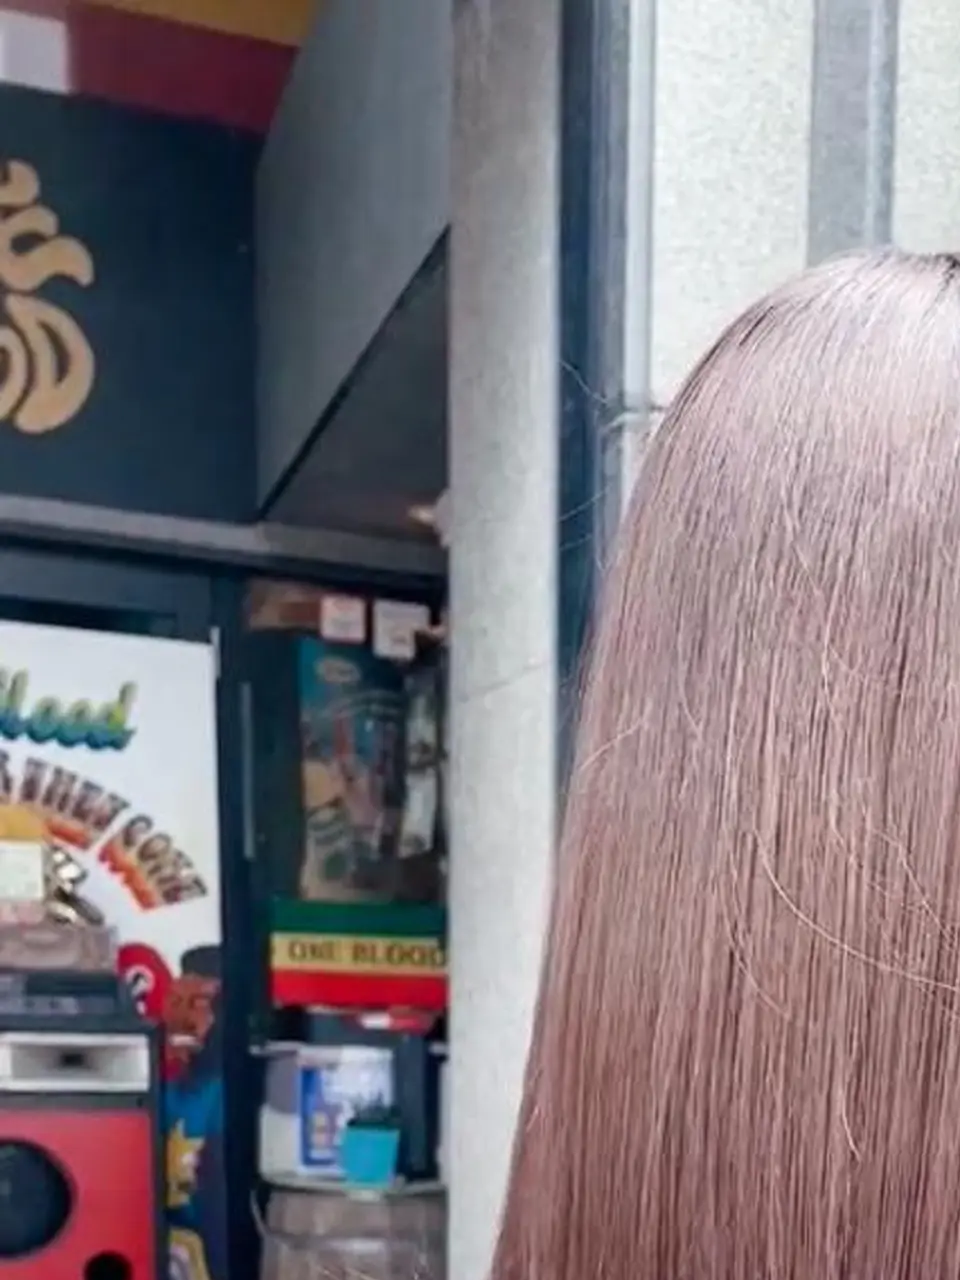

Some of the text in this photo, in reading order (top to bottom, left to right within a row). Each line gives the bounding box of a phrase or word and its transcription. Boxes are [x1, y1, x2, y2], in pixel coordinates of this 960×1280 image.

[0, 667, 137, 752] lood
[287, 939, 447, 968] ONE BLOOD
